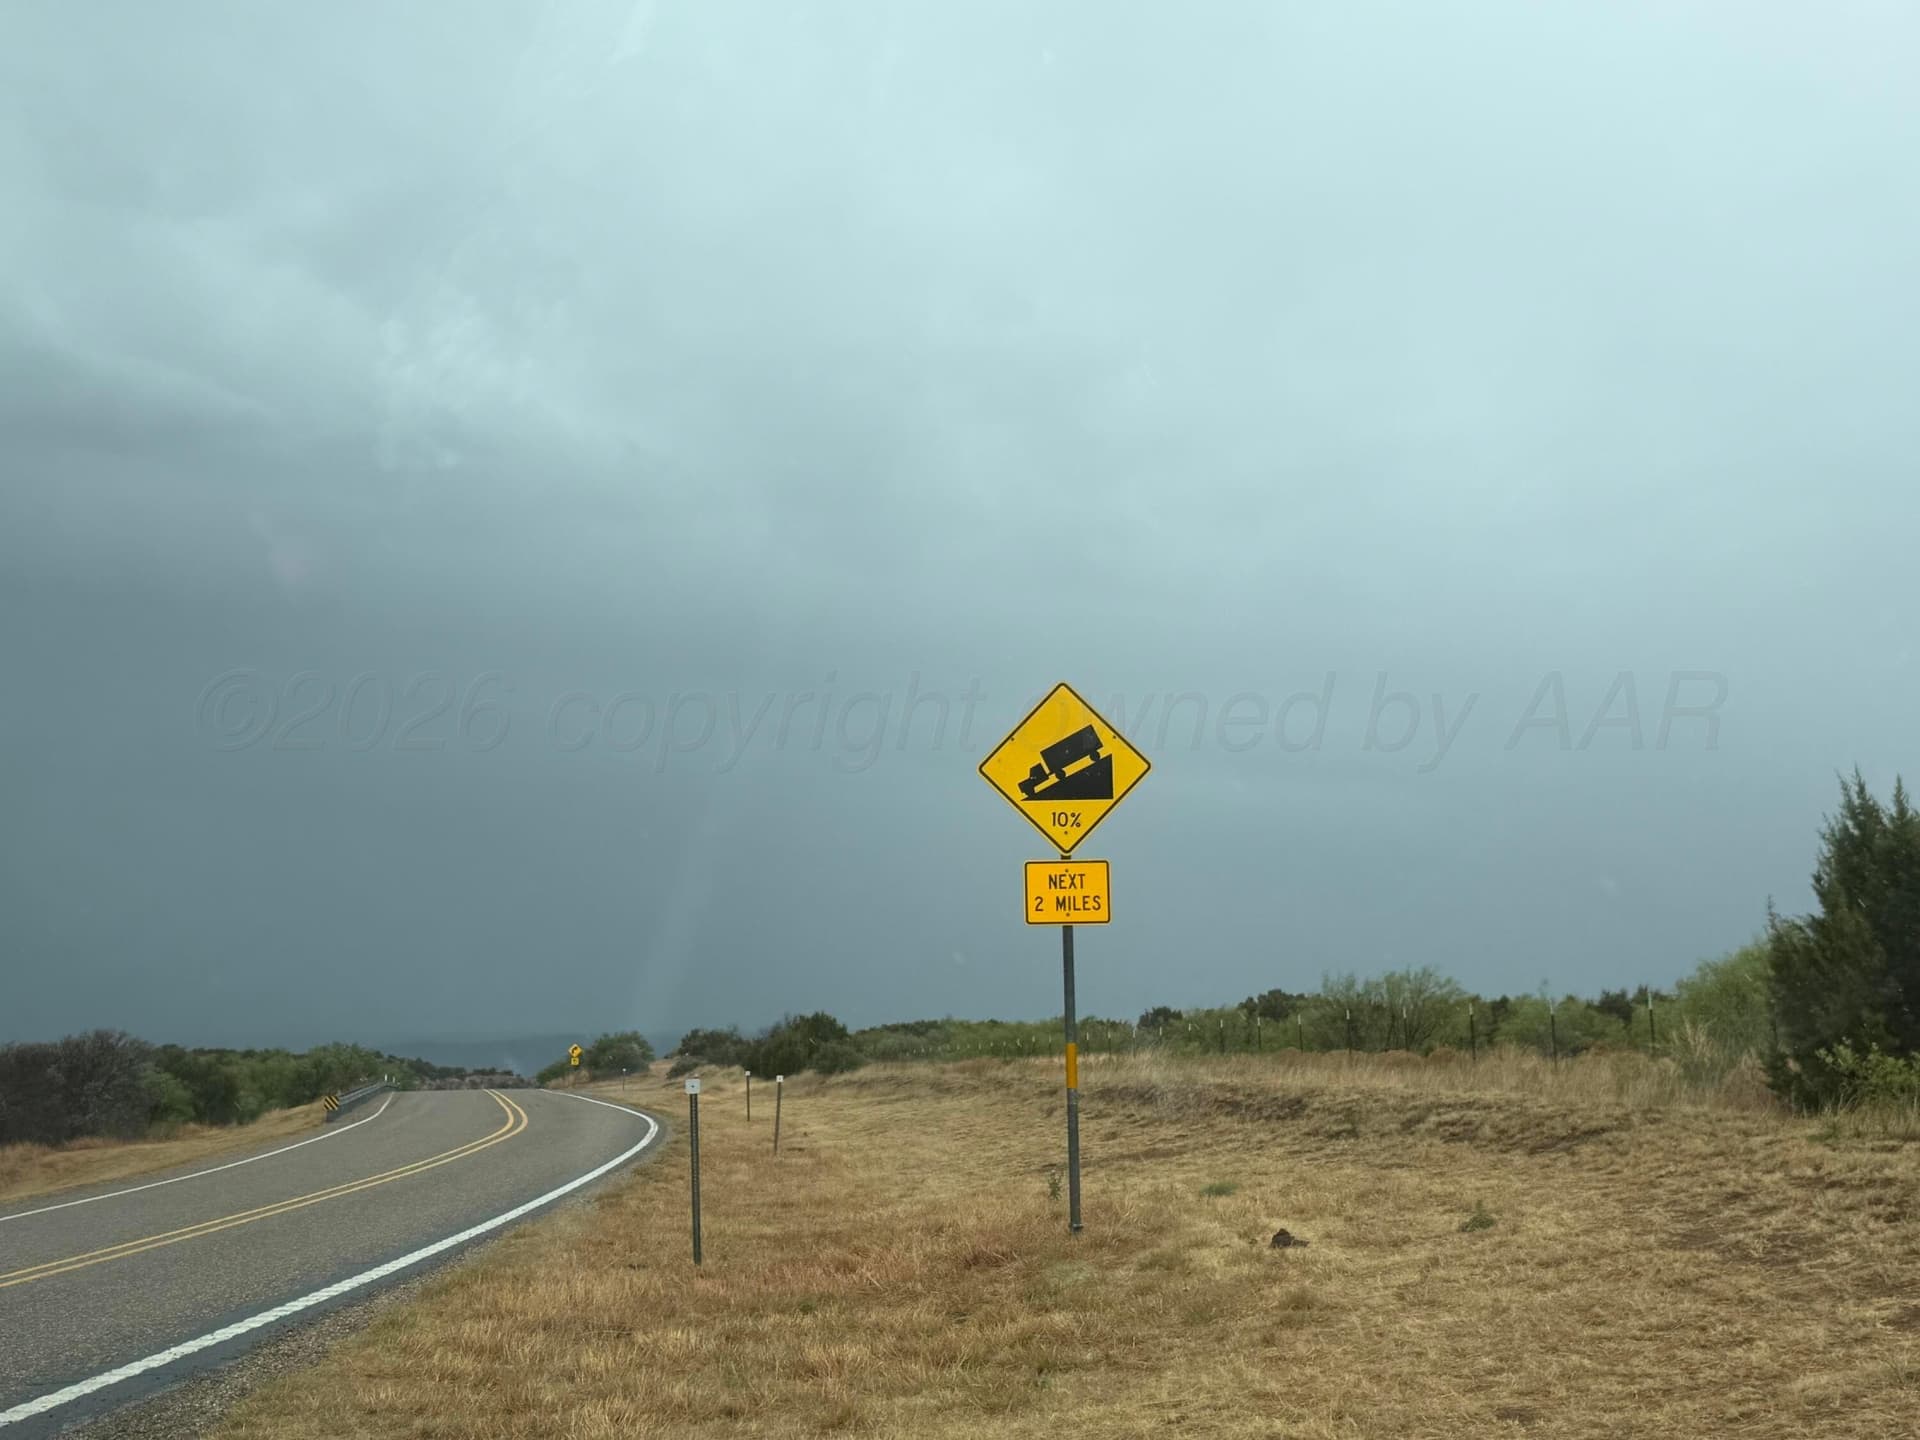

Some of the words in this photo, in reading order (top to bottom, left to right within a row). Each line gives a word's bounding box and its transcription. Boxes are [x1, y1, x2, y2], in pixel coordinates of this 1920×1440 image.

[1052, 811, 1081, 827] 10%
[1048, 873, 1085, 890] NEXT
[1034, 895, 1044, 912] 2
[1055, 894, 1101, 911] MILES
